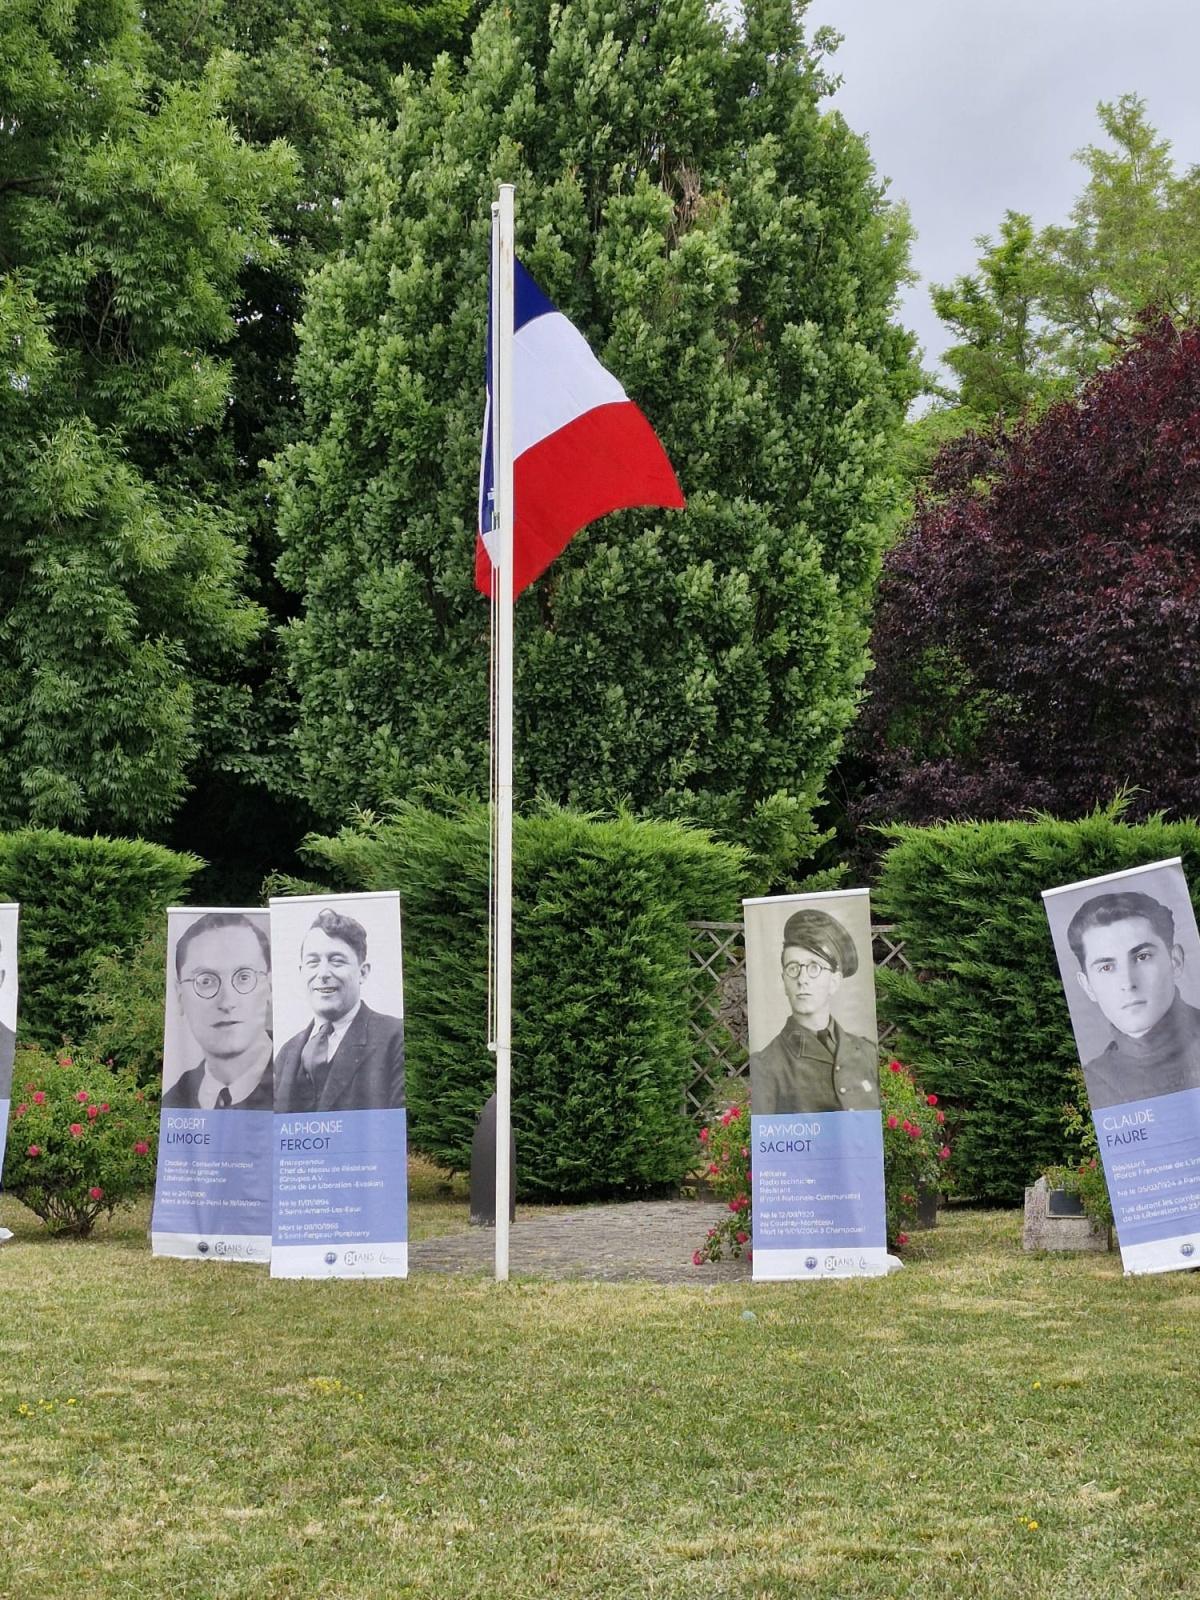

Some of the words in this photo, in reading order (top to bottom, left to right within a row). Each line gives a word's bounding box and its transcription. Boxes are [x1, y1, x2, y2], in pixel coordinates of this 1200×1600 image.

[167, 1117, 207, 1130] ROBERT
[1103, 1109, 1155, 1131] CLAUDE
[280, 1119, 344, 1135] ALPHONSE
[759, 1122, 821, 1137] RAYMOND
[166, 1133, 211, 1145] LIMOGE
[1106, 1127, 1148, 1147] FAURE
[280, 1137, 331, 1151] FERCOT
[759, 1139, 812, 1153] SACHOT
[221, 1160, 254, 1169] Municipal
[280, 1167, 297, 1175] Chef
[297, 1182, 307, 1190] de
[1122, 1214, 1133, 1224] de
[278, 1223, 295, 1232] Mort
[760, 1227, 776, 1236] Mort
